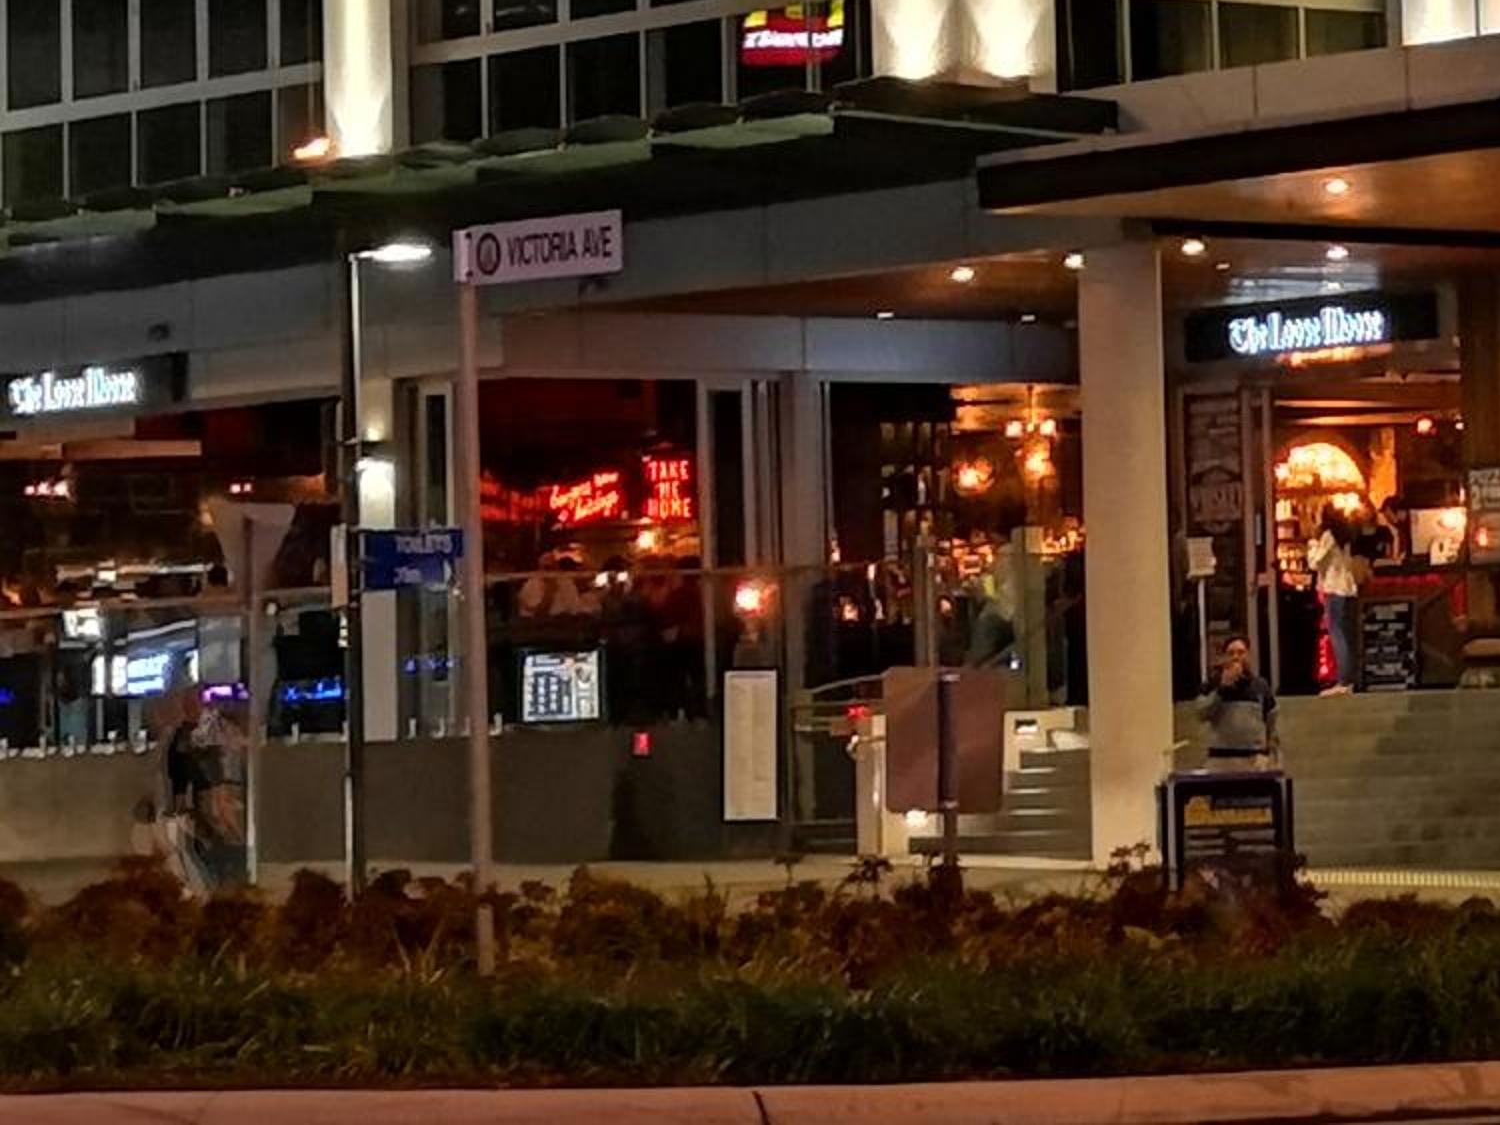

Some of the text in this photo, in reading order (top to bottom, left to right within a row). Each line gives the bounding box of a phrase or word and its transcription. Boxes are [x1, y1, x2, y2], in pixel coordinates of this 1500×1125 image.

[506, 225, 613, 267] VICTORIA AVE
[1228, 316, 1268, 355] The
[648, 460, 689, 481] TAKE
[658, 481, 680, 499] ME
[647, 497, 692, 519] HOME
